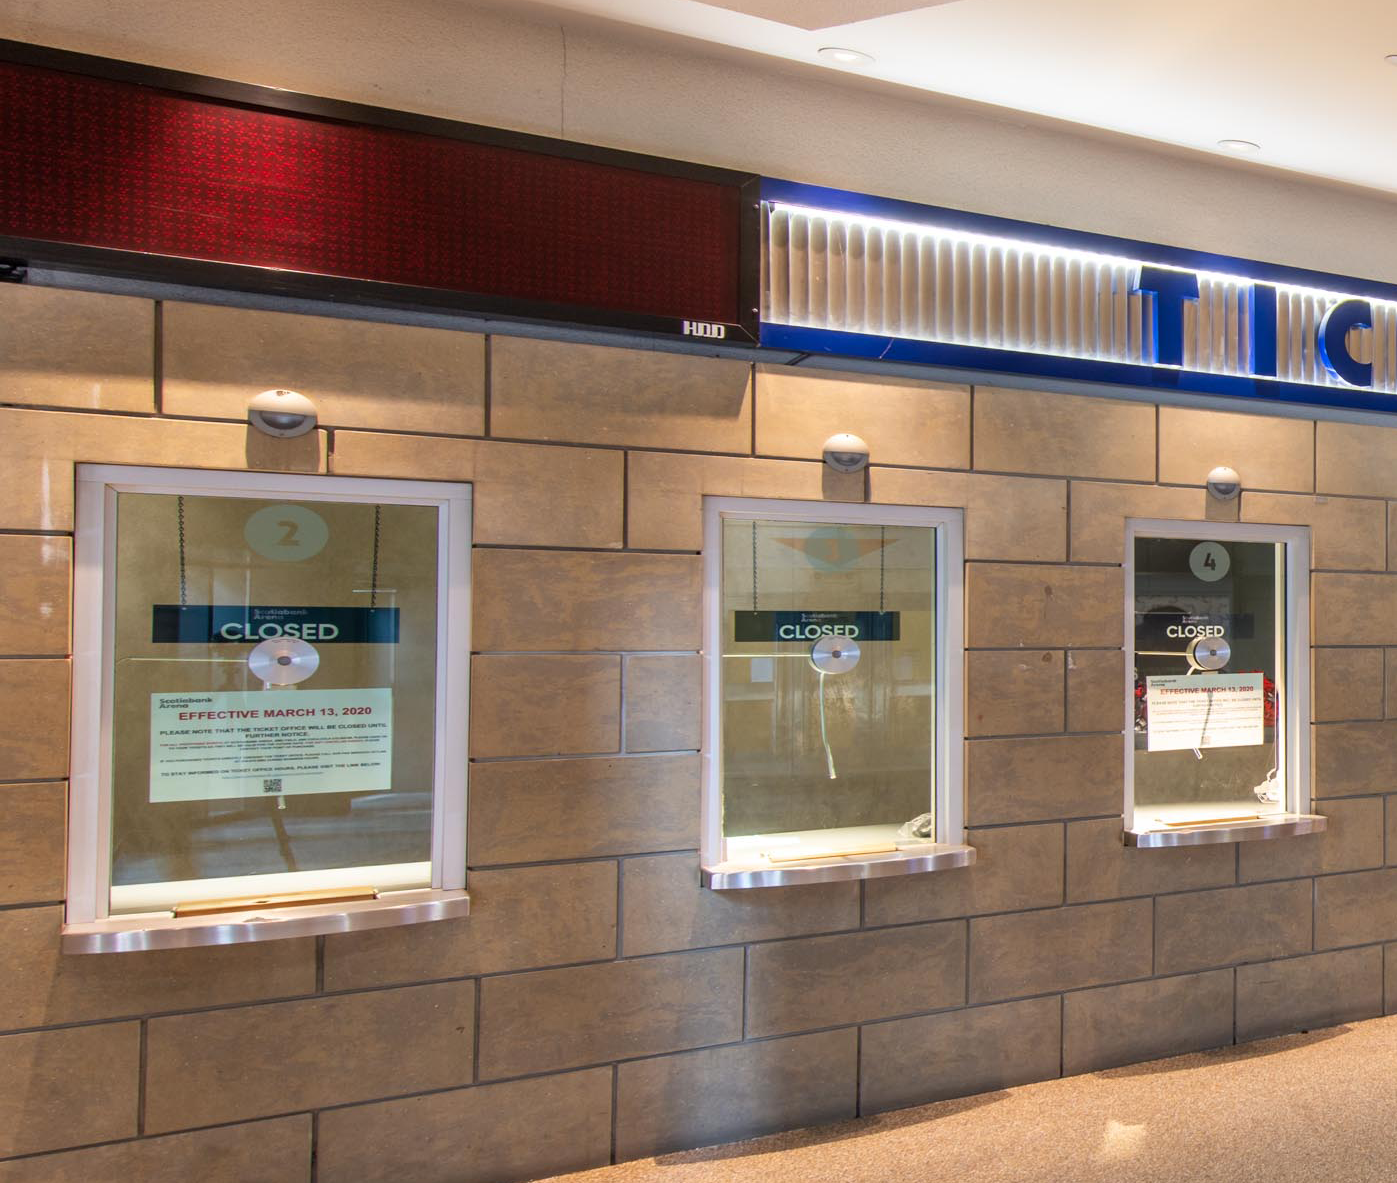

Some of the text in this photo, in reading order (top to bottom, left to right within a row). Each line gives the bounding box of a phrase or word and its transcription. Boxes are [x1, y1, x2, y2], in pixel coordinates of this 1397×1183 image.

[275, 520, 300, 547] 2
[1203, 552, 1217, 571] 4
[253, 608, 309, 616] Scotiabank
[220, 622, 340, 640] CLOSED
[779, 624, 860, 640] CLOSED
[1166, 625, 1225, 638] CLOSED
[1160, 687, 1200, 695] EFFECTIVE
[1201, 686, 1227, 694] MARCH
[159, 697, 213, 705] Scotiabank
[178, 706, 373, 721] EFFECTIVE MARCH 13, 2020
